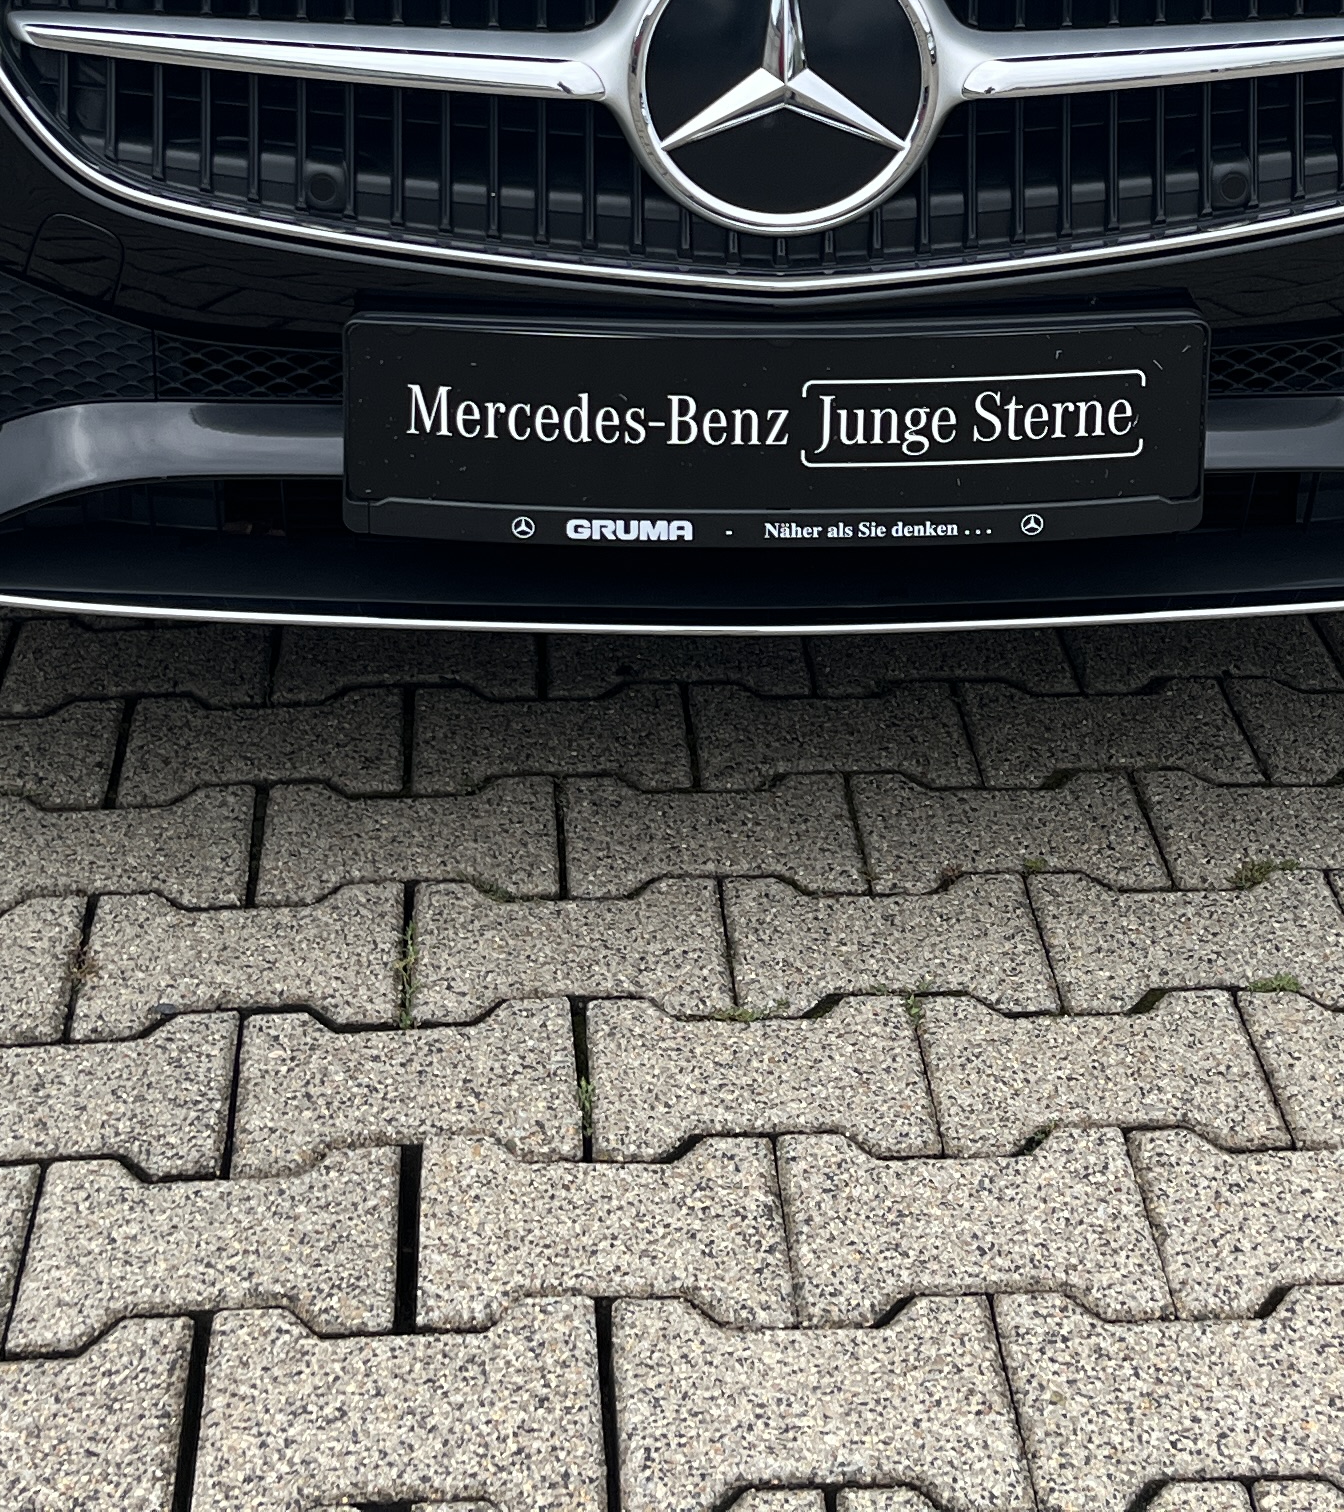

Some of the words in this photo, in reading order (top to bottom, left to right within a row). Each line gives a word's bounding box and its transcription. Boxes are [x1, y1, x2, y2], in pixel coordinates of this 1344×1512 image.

[406, 383, 789, 446] Mercedes-Benz
[813, 395, 957, 456] Junge
[973, 391, 1133, 442] Sterne
[565, 518, 693, 541] GRUMA
[764, 522, 823, 538] Näher
[826, 521, 854, 538] als
[857, 521, 887, 538] Sie
[891, 520, 959, 537] denken
